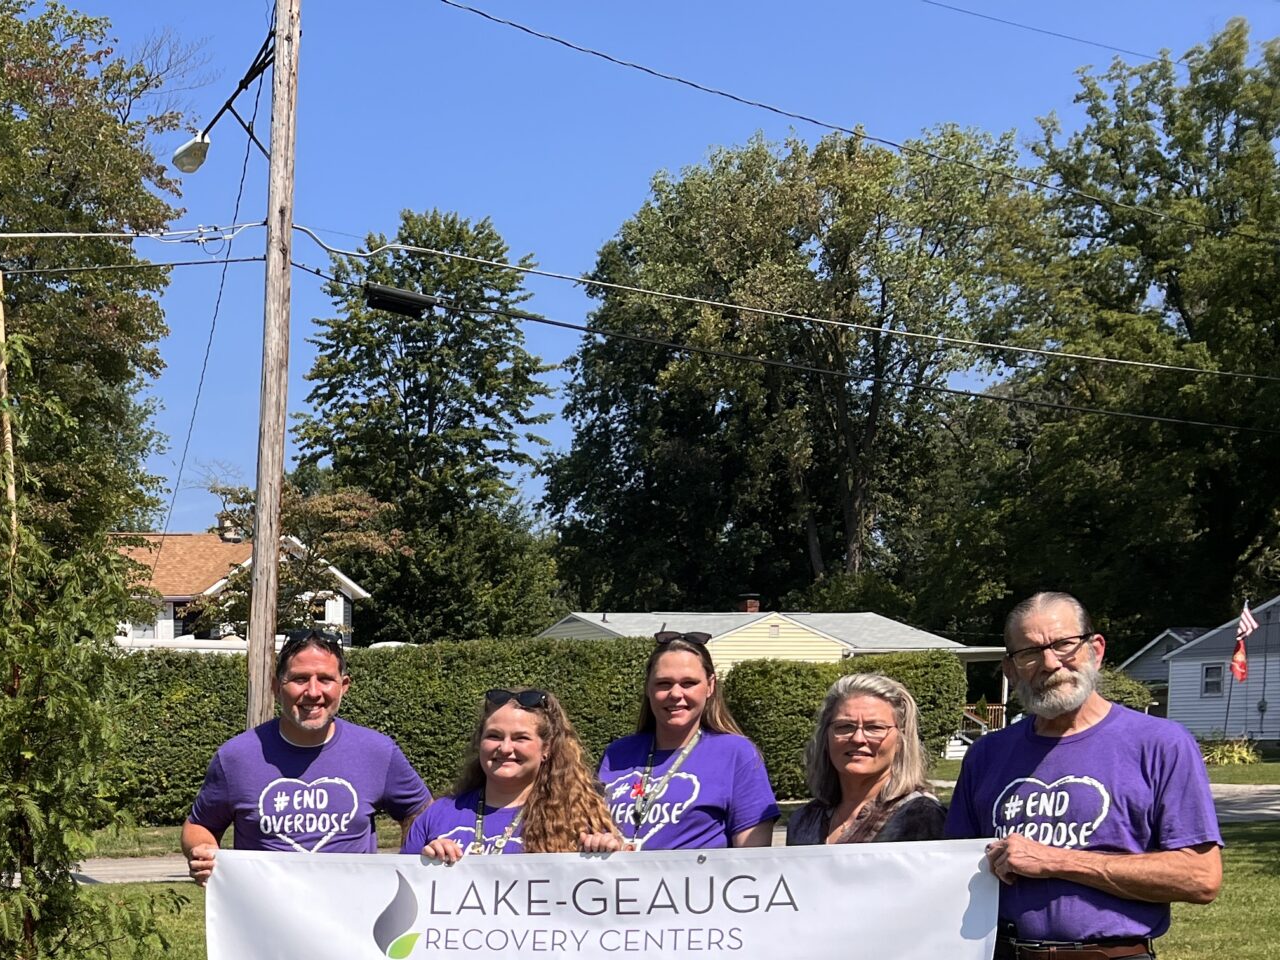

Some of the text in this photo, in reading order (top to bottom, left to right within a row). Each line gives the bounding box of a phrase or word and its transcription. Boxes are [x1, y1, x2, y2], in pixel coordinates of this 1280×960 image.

[273, 788, 329, 812] #END
[1004, 790, 1070, 820] #END
[260, 812, 351, 835] OVERDOSE
[429, 873, 800, 917] LAKE-GEAUGA
[425, 927, 744, 952] RECOVERY CENTERS
